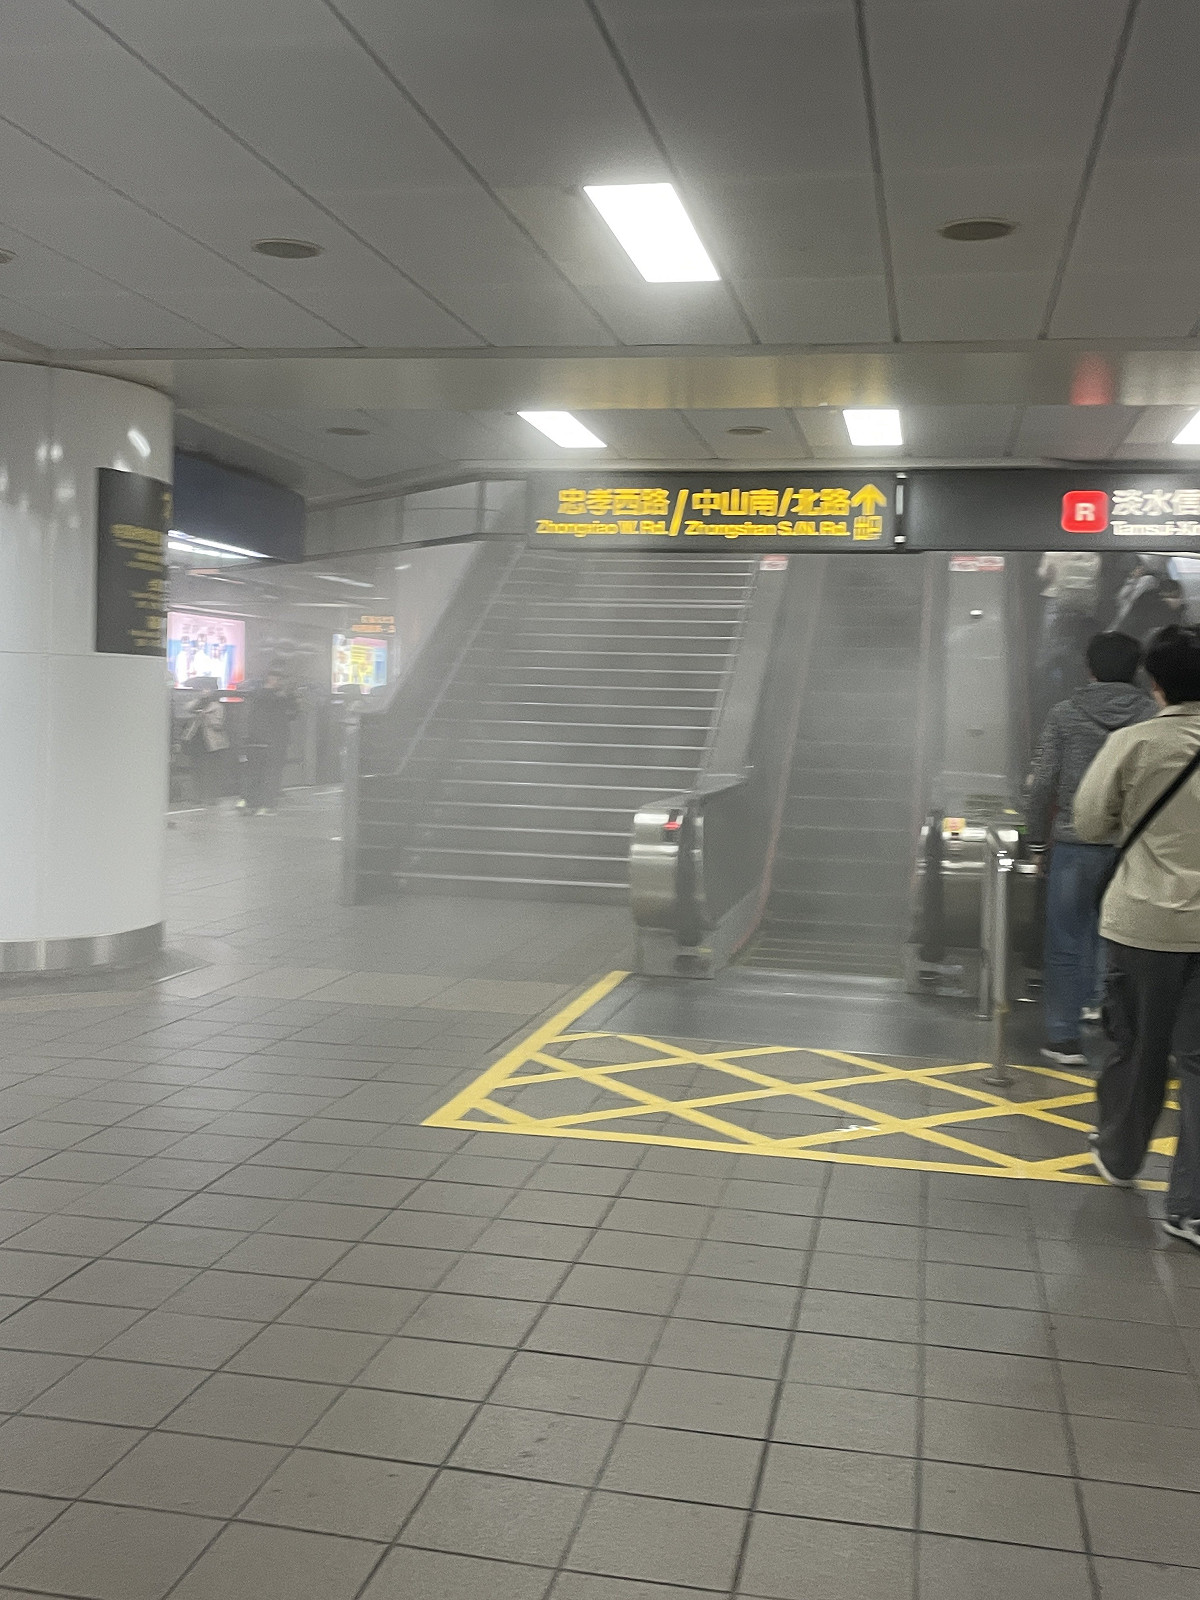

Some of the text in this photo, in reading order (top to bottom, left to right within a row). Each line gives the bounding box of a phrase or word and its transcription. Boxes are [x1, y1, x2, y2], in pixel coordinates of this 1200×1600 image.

[1075, 502, 1095, 521] R
[535, 519, 618, 538] Zhongxiao
[684, 520, 777, 539] Zhongshan
